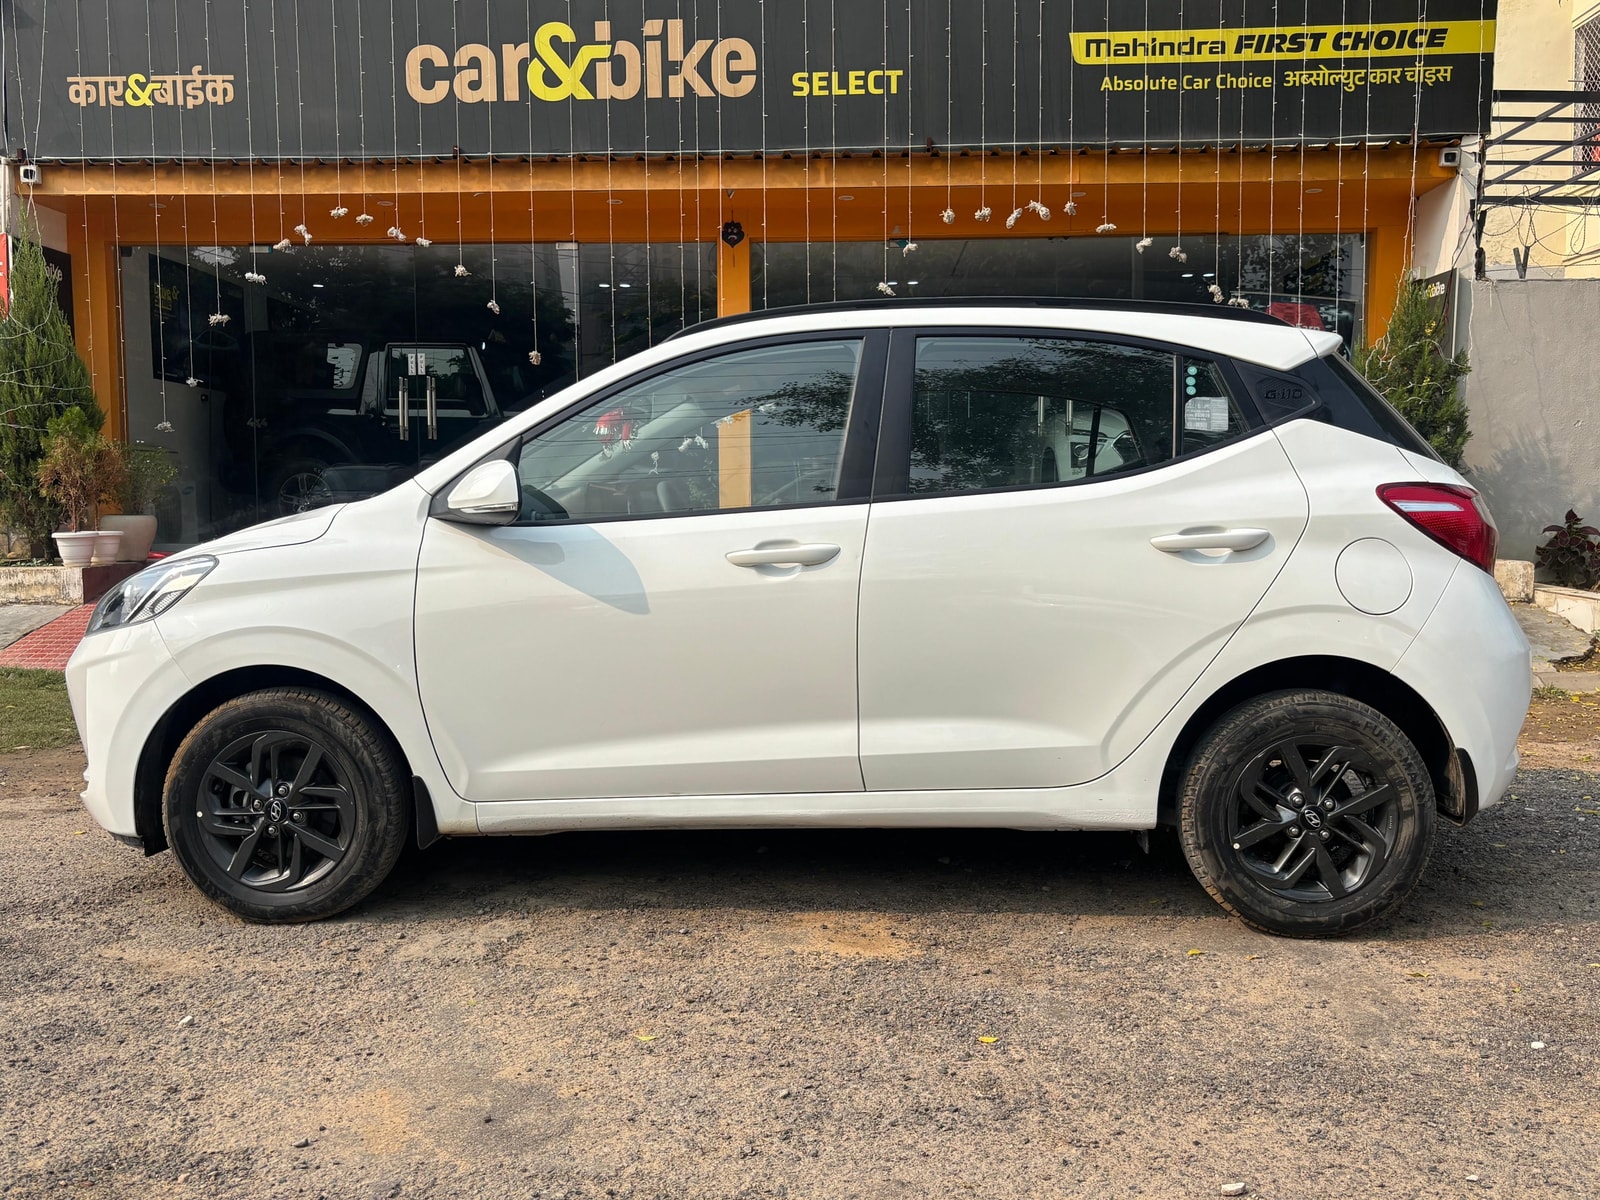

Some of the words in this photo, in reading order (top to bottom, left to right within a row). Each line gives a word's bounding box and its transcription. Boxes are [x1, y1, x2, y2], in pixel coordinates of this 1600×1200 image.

[1085, 37, 1226, 58] Mahindra
[1234, 32, 1328, 54] FIRST
[1331, 28, 1449, 52] CHOICE
[405, 19, 757, 104] car&bike
[1368, 67, 1402, 85] कार
[66, 65, 235, 109] कार&बाईक
[791, 69, 904, 97] SELECT
[1100, 74, 1178, 91] Absolute
[1182, 74, 1211, 90] Car
[1216, 72, 1273, 89] Choice
